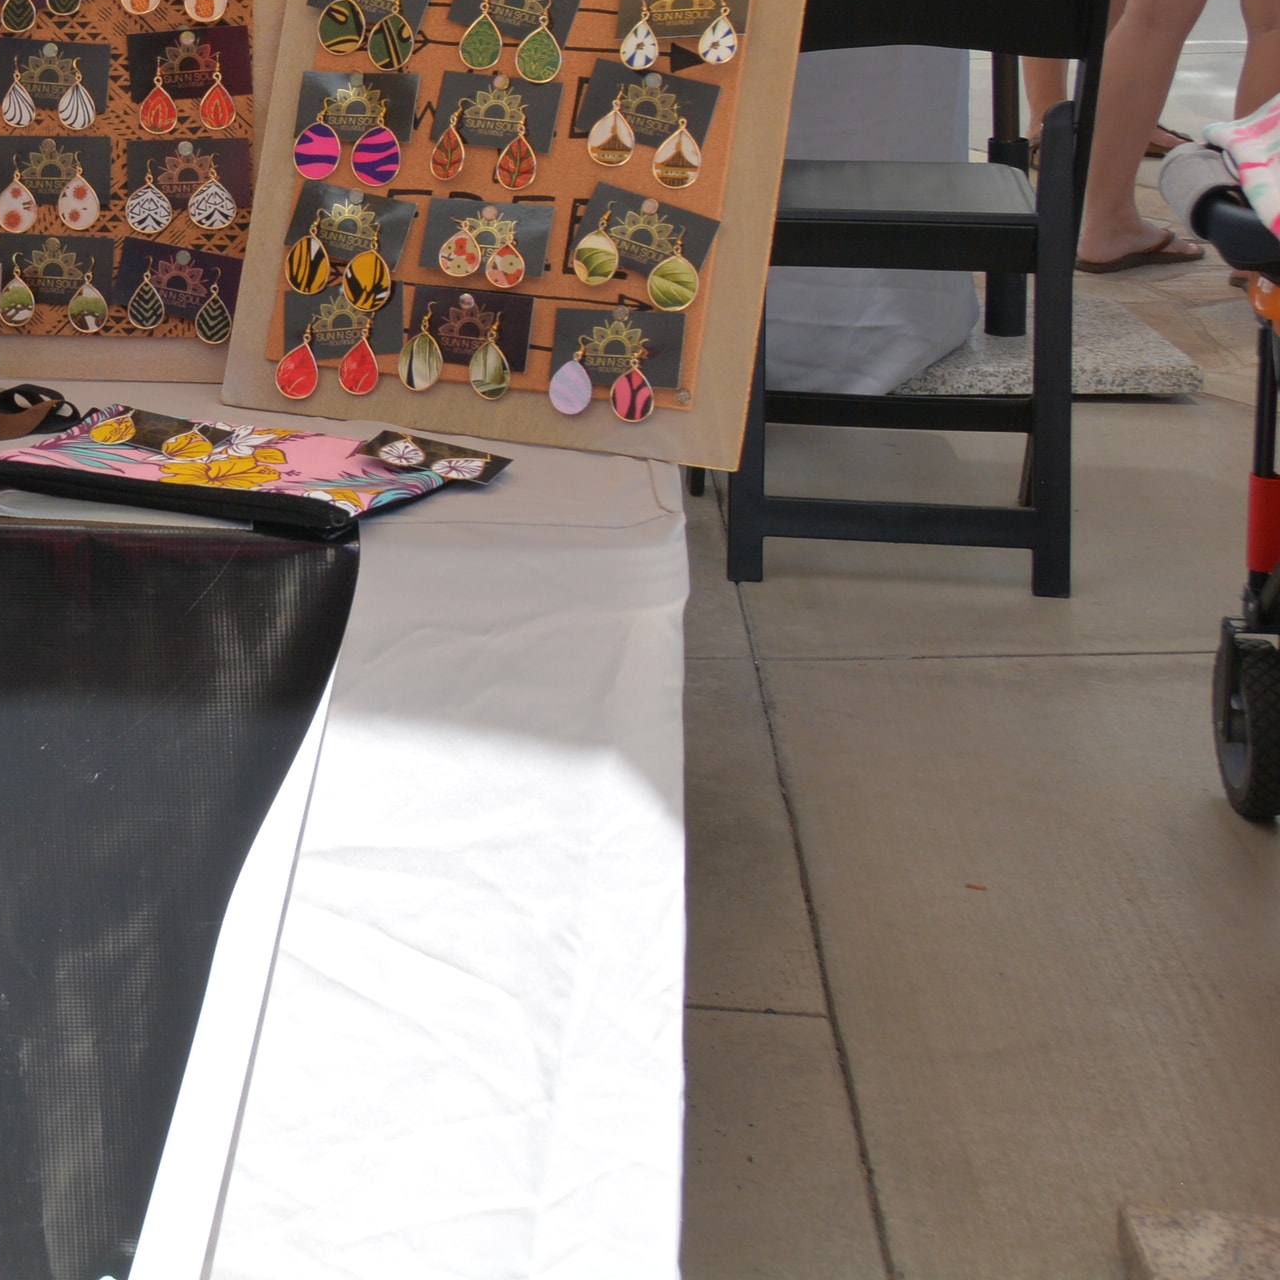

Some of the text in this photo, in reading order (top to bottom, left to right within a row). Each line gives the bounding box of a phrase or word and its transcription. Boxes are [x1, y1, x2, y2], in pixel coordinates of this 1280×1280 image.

[513, 10, 537, 25] SOUL
[653, 10, 711, 22] SUN N SOUL
[164, 76, 183, 85] SUN
[328, 116, 347, 125] SUN
[348, 117, 355, 125] N
[465, 119, 485, 128] SUN
[487, 120, 494, 128] N
[646, 119, 671, 133] SOUL
[25, 183, 44, 191] SUN
[162, 185, 182, 193] SUN
[319, 229, 371, 248] SUN N SOUL
[57, 279, 81, 289] SOUL
[179, 293, 202, 306] SOUL
[316, 332, 335, 342] SUN
[336, 331, 344, 340] N
[441, 337, 461, 347] SUN
[585, 357, 605, 366] SUN
[607, 357, 615, 366] N
